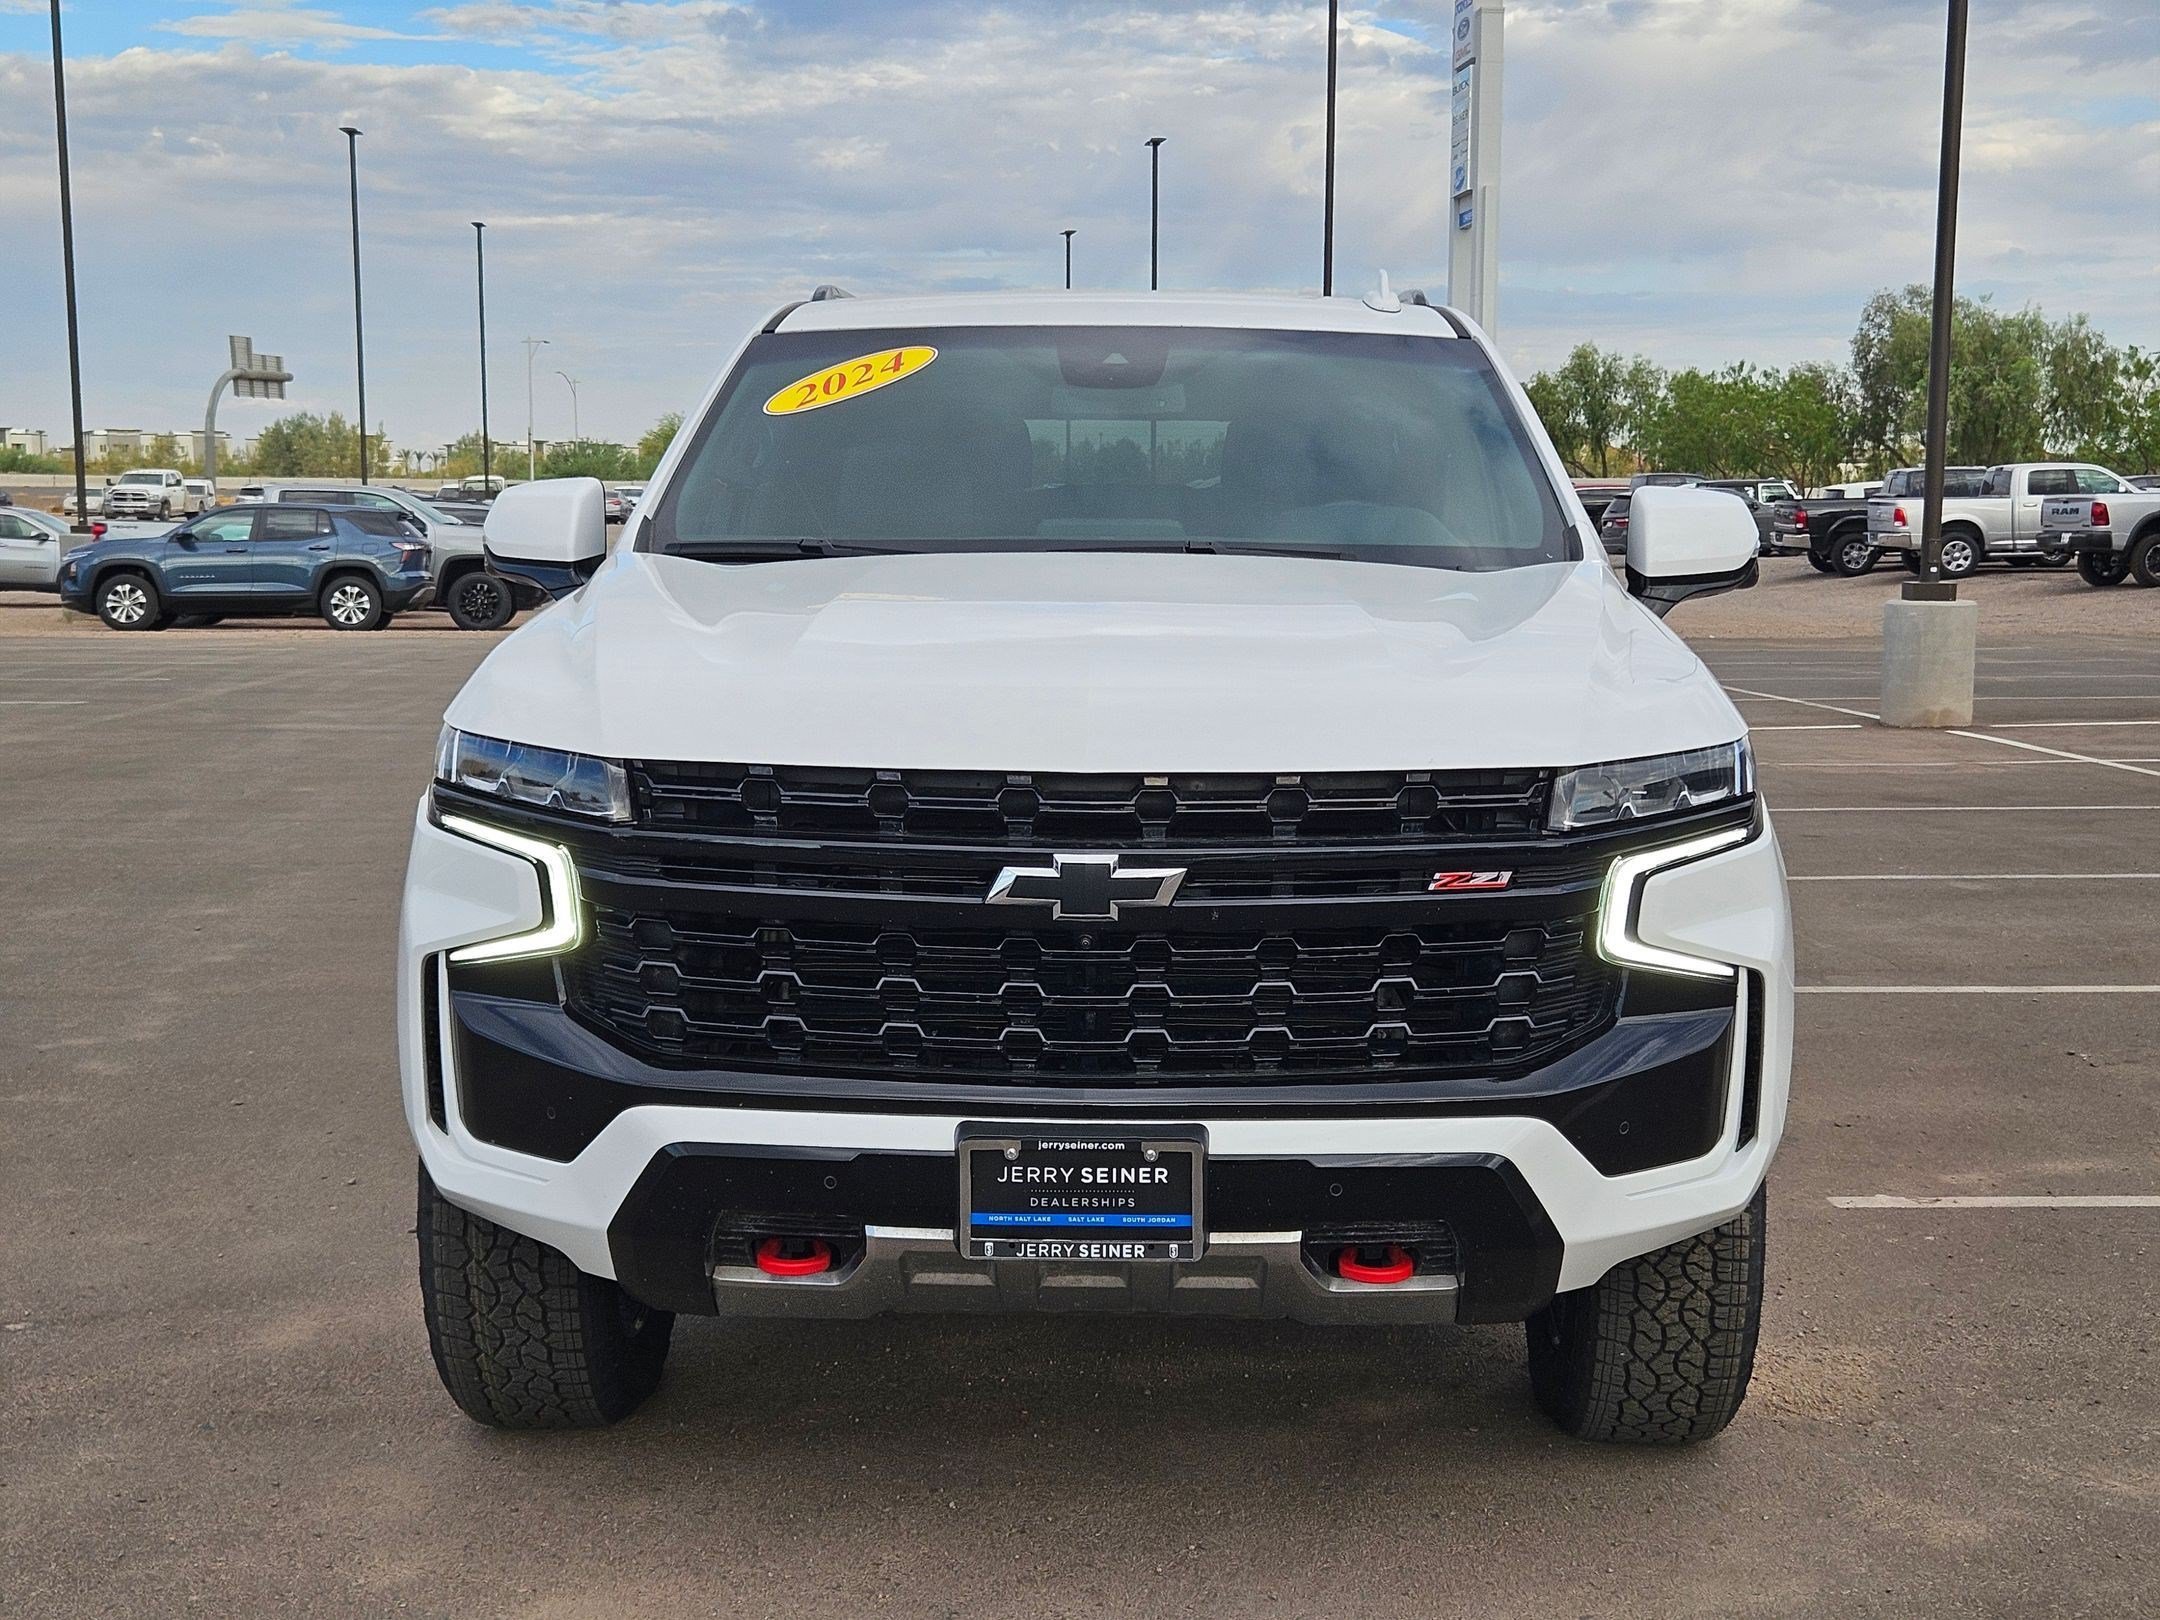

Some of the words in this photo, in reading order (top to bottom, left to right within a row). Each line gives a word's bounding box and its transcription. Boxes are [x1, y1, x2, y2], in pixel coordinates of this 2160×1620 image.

[795, 351, 905, 409] 2024
[2051, 507, 2080, 516] RAM
[1428, 871, 1513, 890] Z71
[1037, 1139, 1126, 1151] jerryseiner.com
[997, 1166, 1075, 1184] JERRY
[1080, 1167, 1169, 1184] SEINER
[1030, 1197, 1136, 1208] DEALERSHIPS
[1016, 1243, 1075, 1258] JERRY
[1079, 1244, 1145, 1258] SEINER
